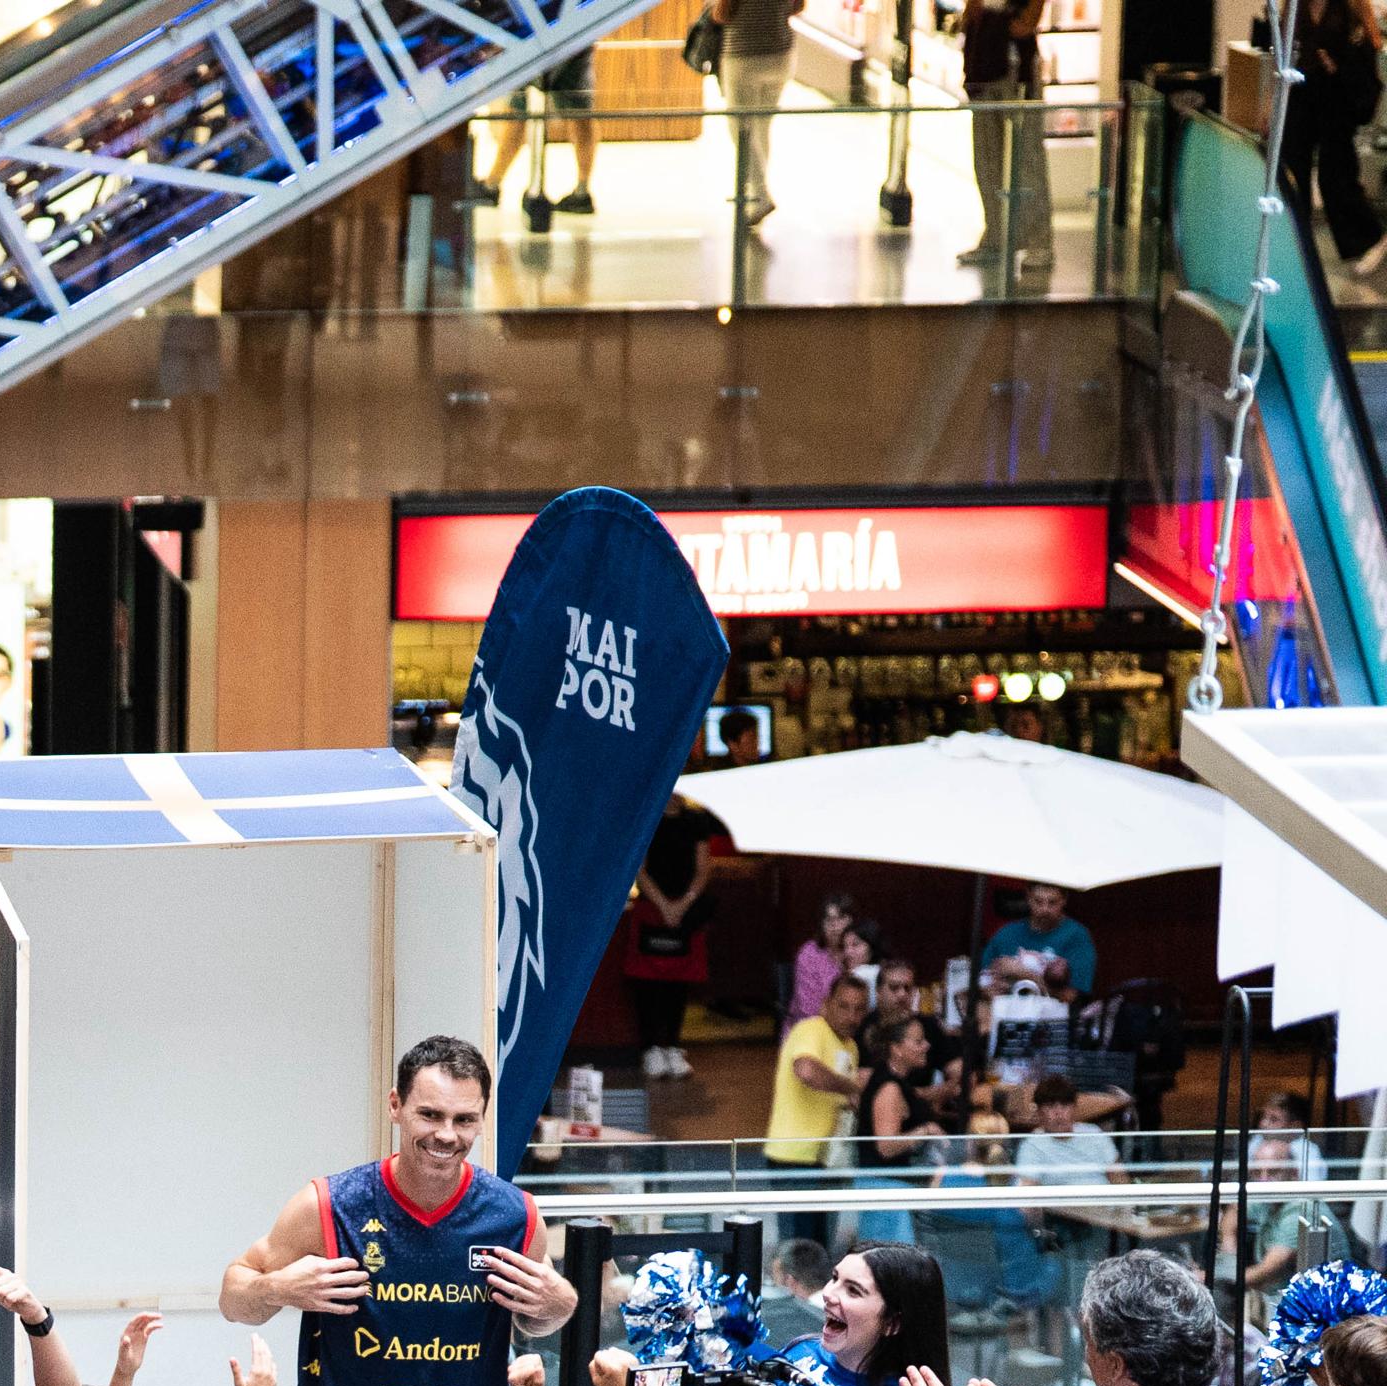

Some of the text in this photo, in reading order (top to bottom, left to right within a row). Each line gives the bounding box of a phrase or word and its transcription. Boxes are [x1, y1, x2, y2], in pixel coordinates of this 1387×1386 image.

[566, 606, 637, 678] MAI
[555, 658, 636, 731] POR
[384, 1337, 481, 1361] Andorr
